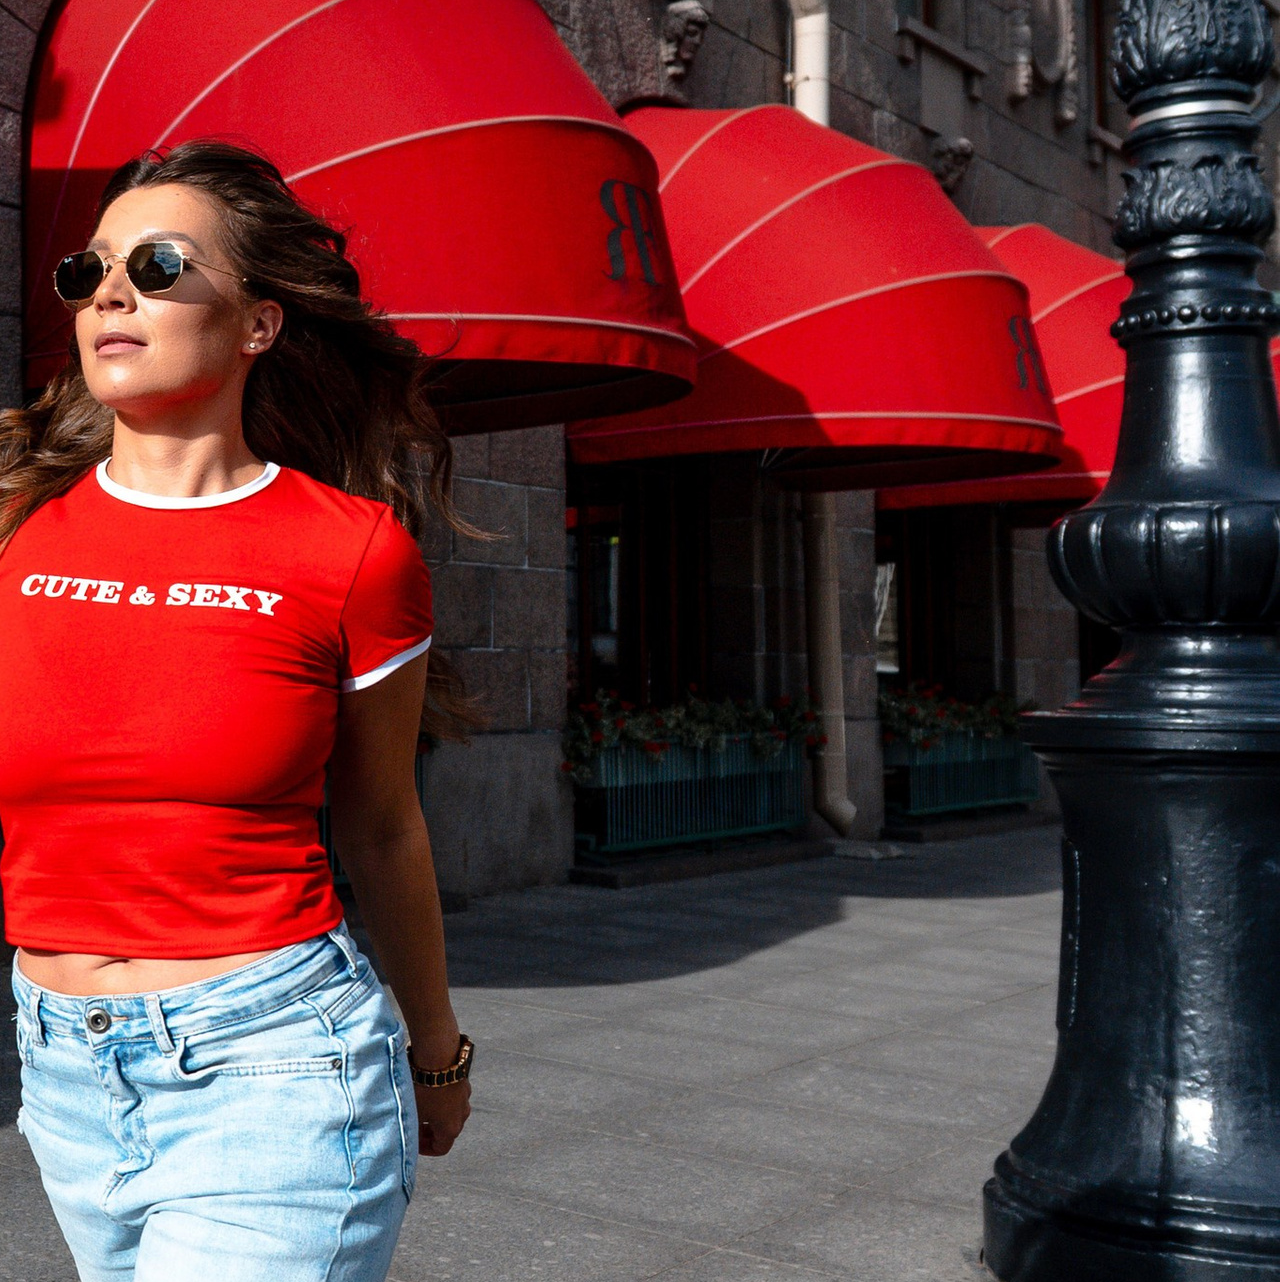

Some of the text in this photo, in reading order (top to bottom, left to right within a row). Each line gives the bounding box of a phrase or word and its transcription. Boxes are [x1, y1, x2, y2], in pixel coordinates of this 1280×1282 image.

[20, 573, 283, 616] CUTE & SEXY
